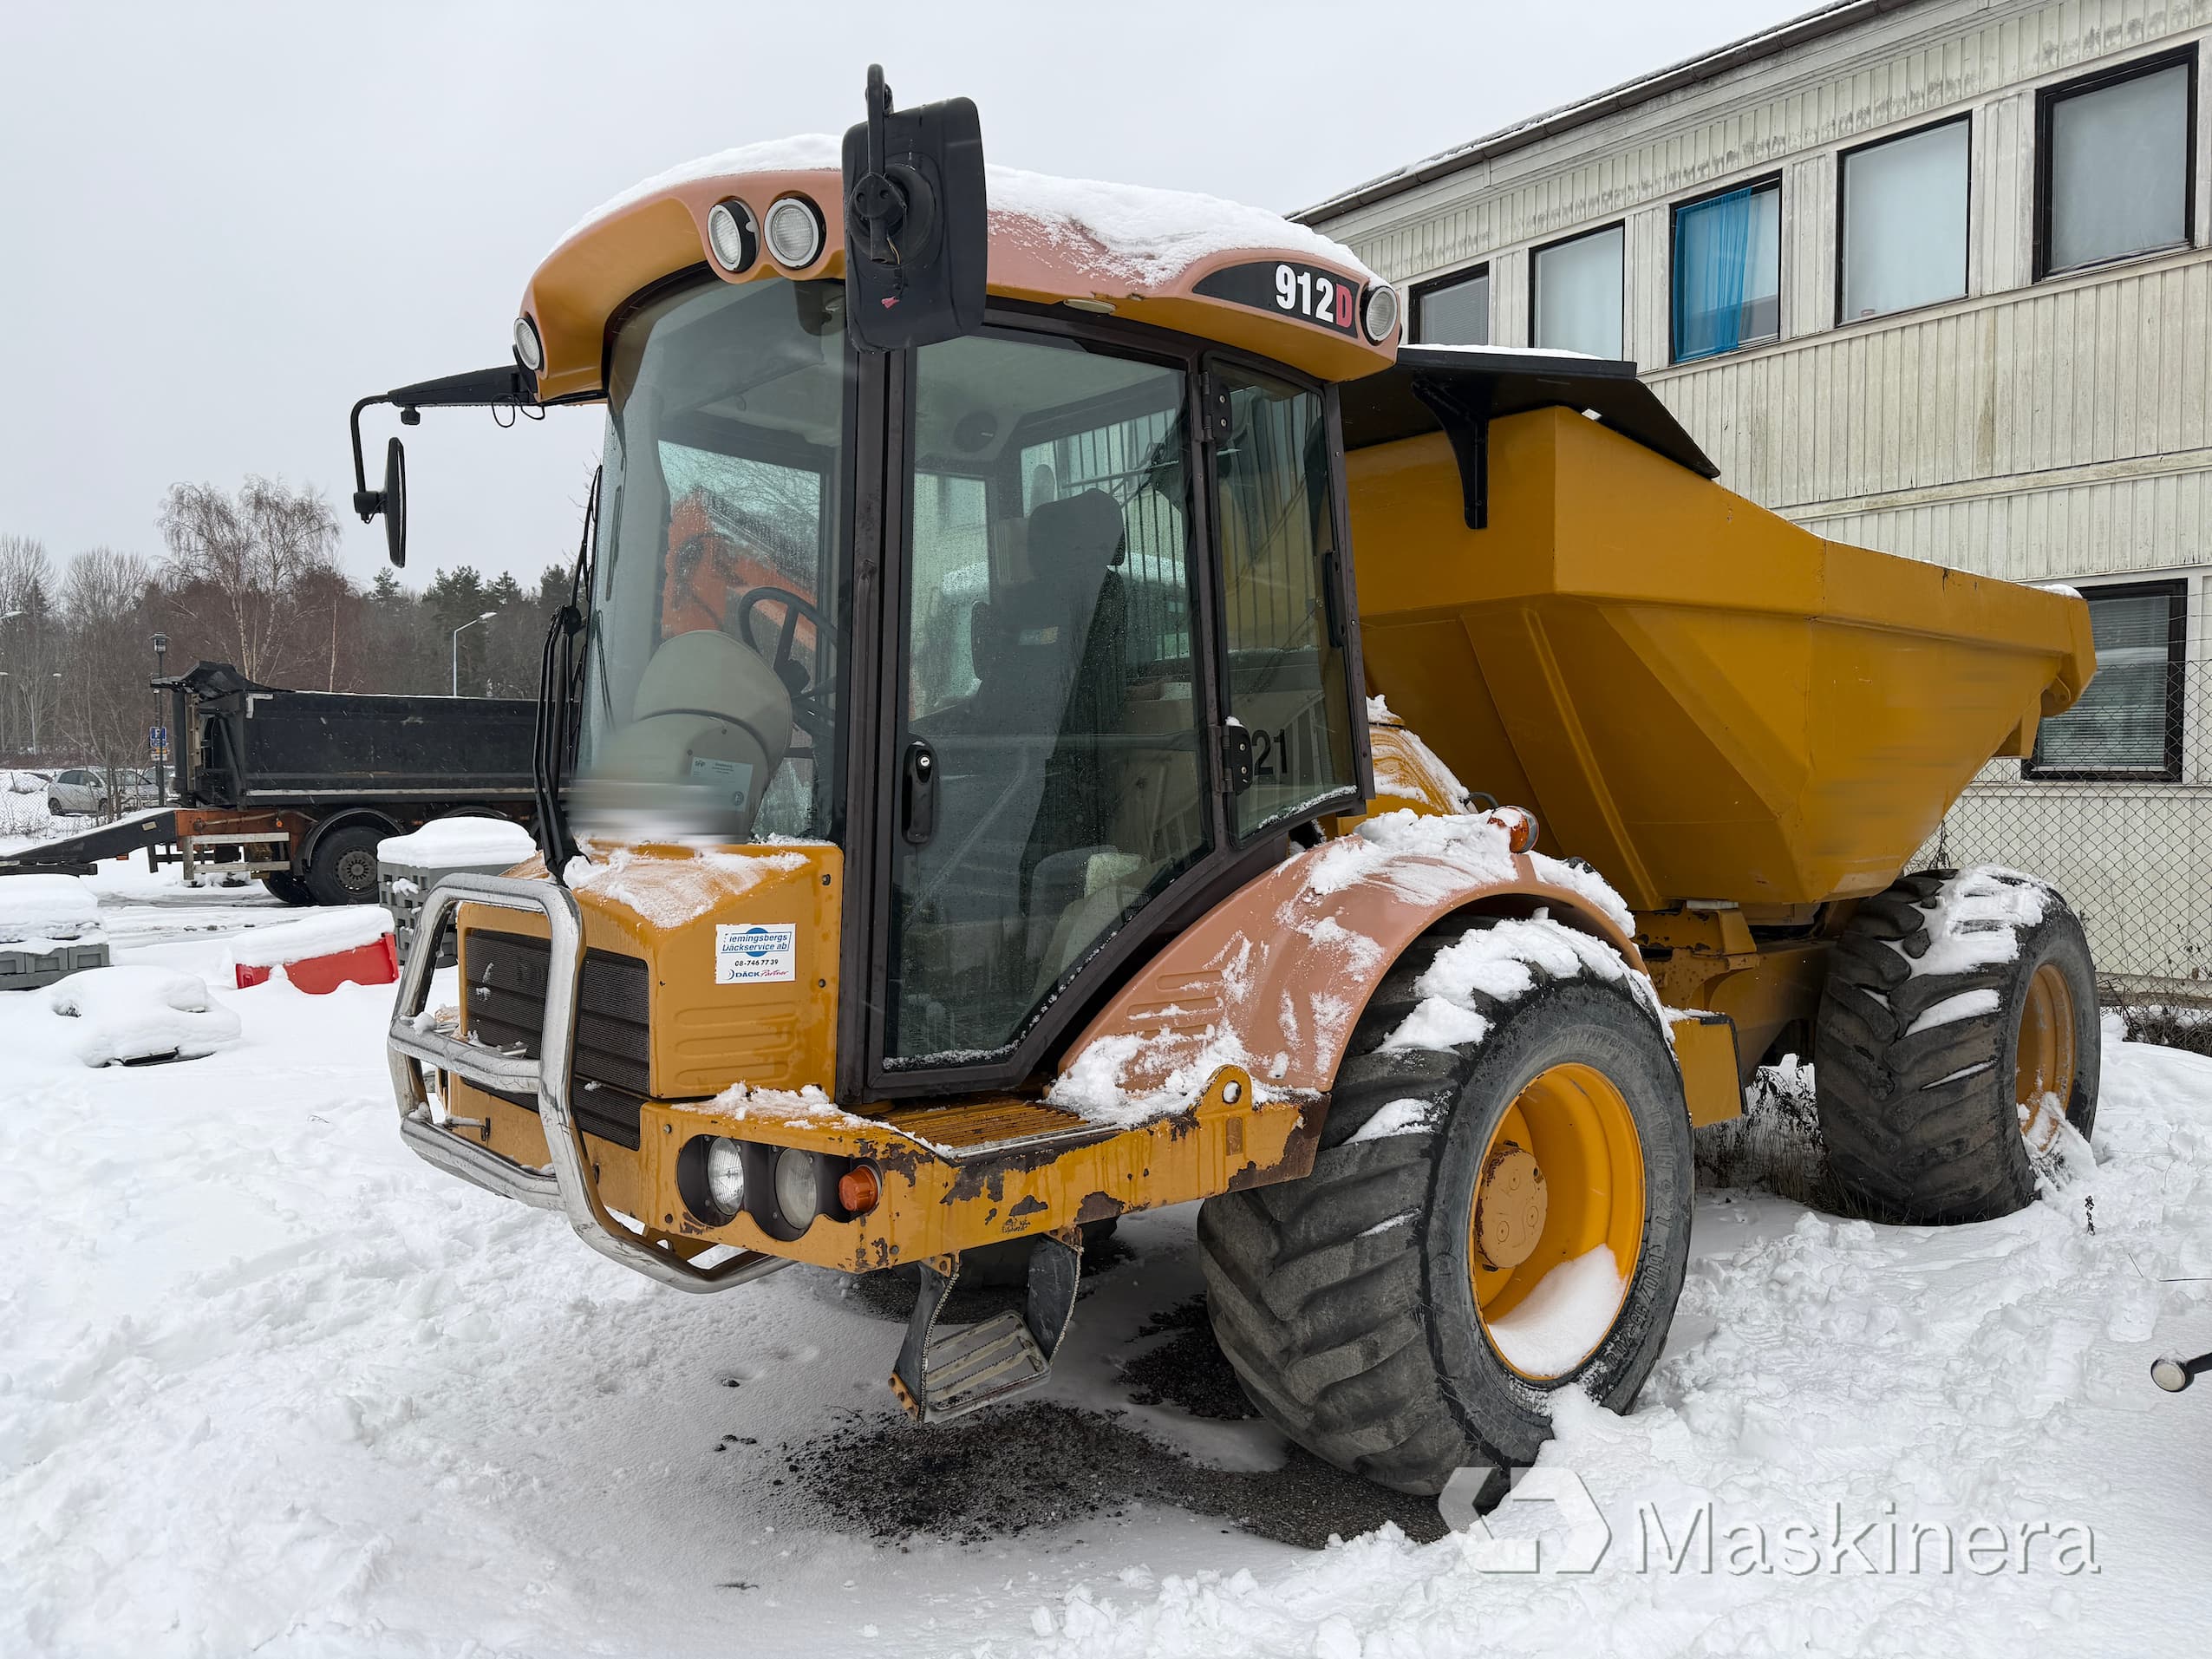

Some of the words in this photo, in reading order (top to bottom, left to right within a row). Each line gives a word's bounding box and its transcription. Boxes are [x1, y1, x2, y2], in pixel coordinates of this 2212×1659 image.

[1276, 264, 1353, 328] 912D
[1251, 728, 1288, 775] 21
[724, 933, 787, 944] lemingsbergs
[776, 942, 788, 950] ab
